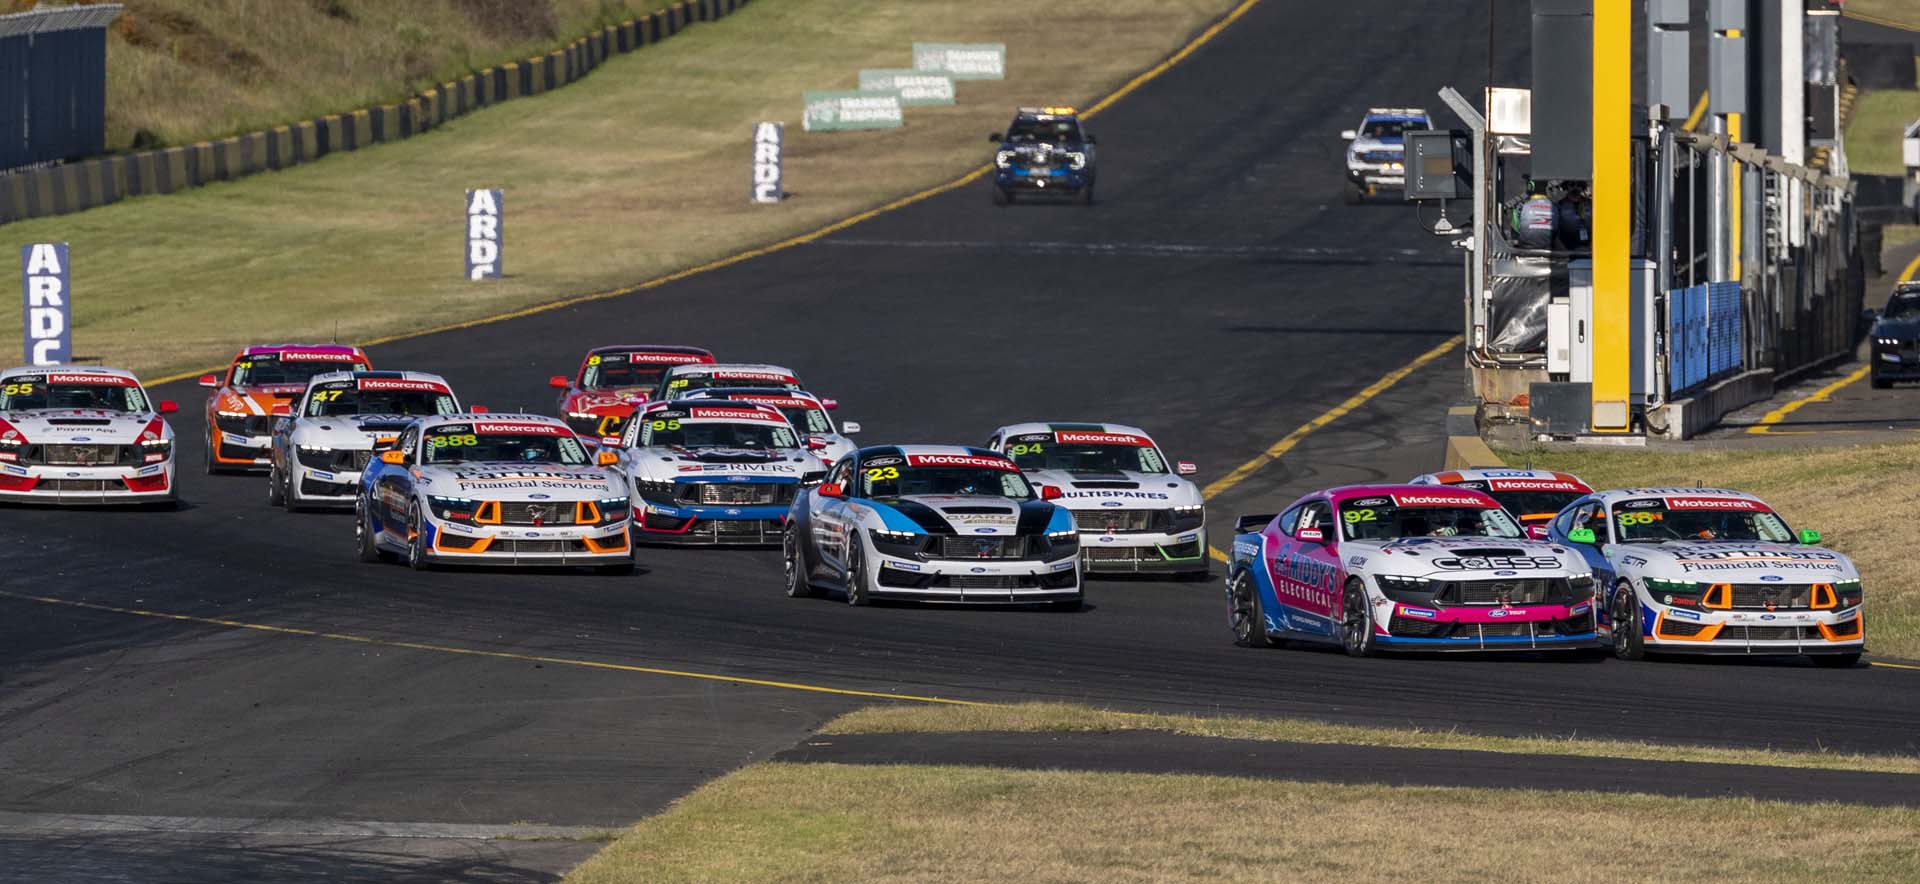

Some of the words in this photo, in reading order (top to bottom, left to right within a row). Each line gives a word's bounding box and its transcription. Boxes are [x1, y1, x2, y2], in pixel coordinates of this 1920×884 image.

[755, 122, 780, 203] ARDC
[27, 244, 63, 366] ARDC
[287, 353, 353, 361] Motorcraft
[636, 355, 701, 363] Motorcraft
[53, 375, 124, 384] Motorcraft
[719, 371, 785, 381] Motorcraft
[5, 383, 33, 396] 55
[364, 381, 436, 390] Motorcraft
[313, 390, 343, 402] 47
[697, 411, 771, 420] Motorcraft
[480, 424, 558, 433] Motorcraft
[652, 421, 681, 431] 95
[433, 435, 478, 448] 888
[1063, 434, 1136, 443] Motorcraft
[1014, 443, 1042, 455] 94
[730, 463, 795, 473] RIVERS
[918, 456, 1014, 470] Motorcraft
[456, 471, 606, 480] Partners
[868, 467, 899, 480] 23
[460, 480, 537, 491] Financial
[542, 481, 609, 492] Services
[1497, 482, 1576, 490] Motorcraft
[1402, 495, 1484, 505] Motorcraft
[1672, 500, 1756, 509] Motorcraft
[1345, 509, 1376, 522] 92
[1621, 512, 1654, 525] 88
[1673, 550, 1835, 560] Partners
[1679, 561, 1766, 573] Financial
[1773, 561, 1844, 572] Services
[1280, 579, 1331, 608] ELECTRICAL
